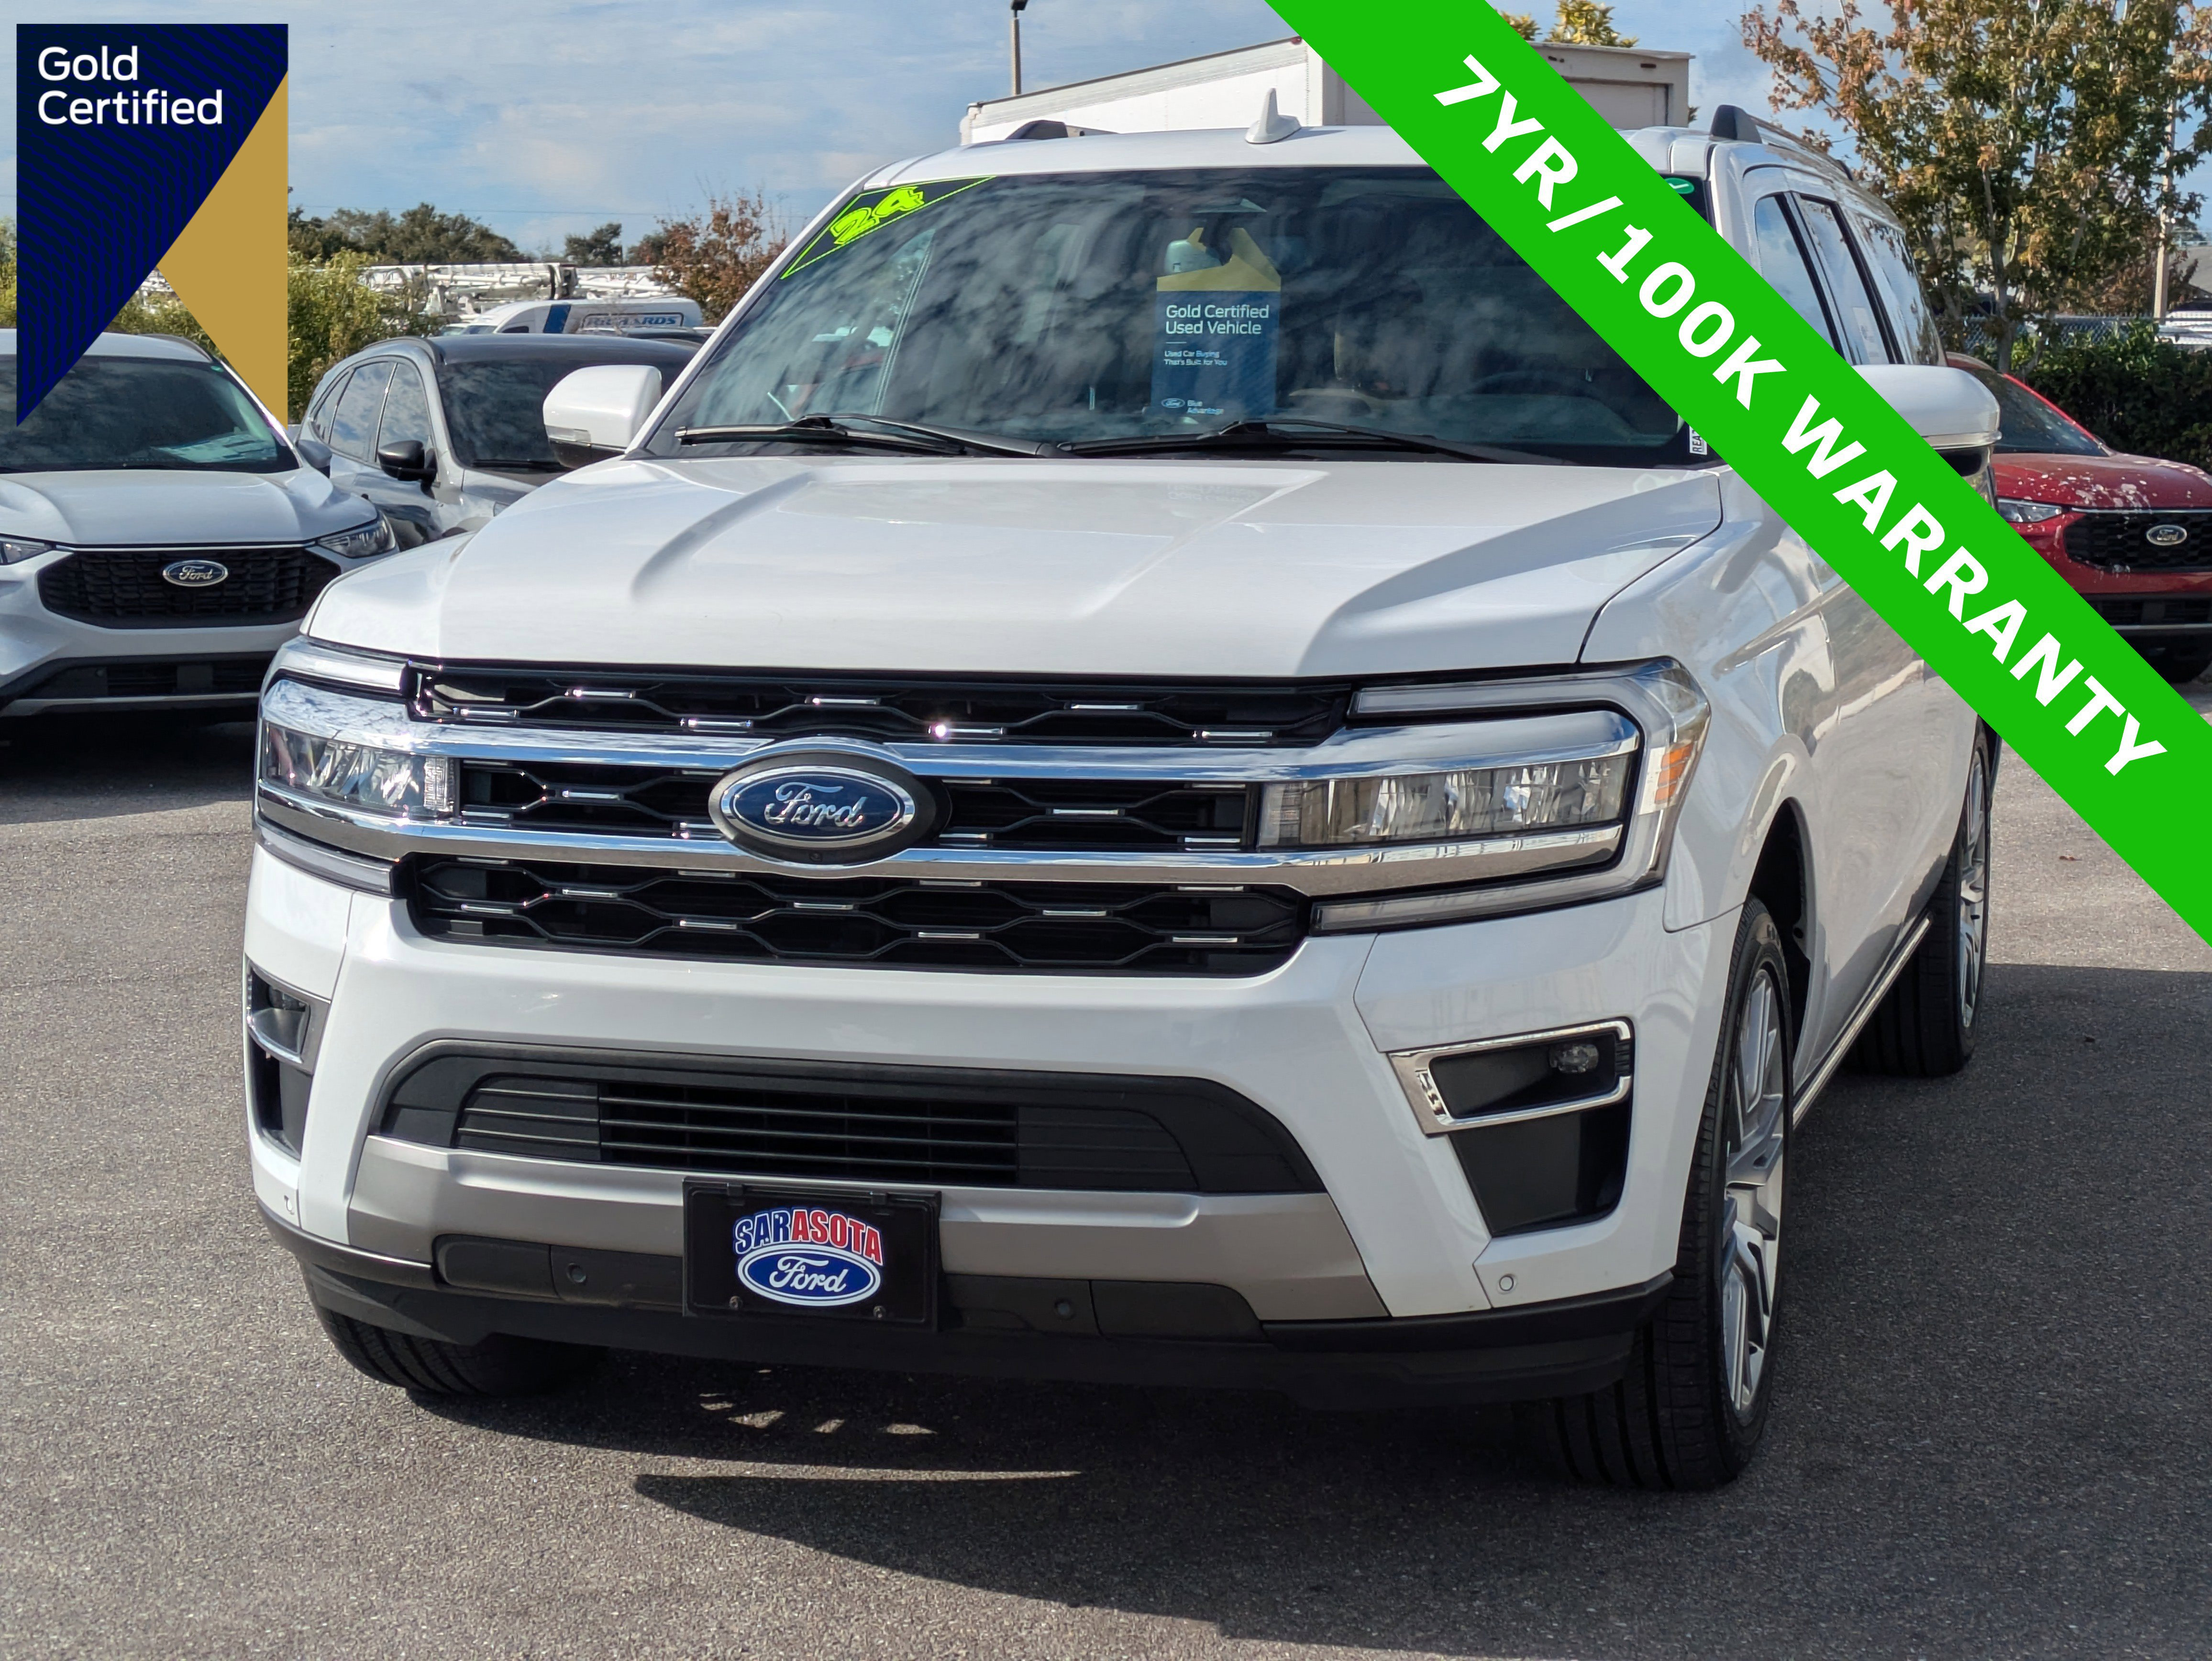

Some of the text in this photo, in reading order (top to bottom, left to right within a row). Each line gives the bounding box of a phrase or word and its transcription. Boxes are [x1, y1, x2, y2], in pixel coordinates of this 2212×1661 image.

[830, 187, 924, 245] 24
[1165, 320, 1262, 334] Used Vehicle
[1166, 304, 1270, 319] Gold Certified
[179, 565, 214, 580] Ford
[764, 781, 868, 828] Ford
[735, 1209, 884, 1266] SARASOTA
[769, 1255, 849, 1293] Ford
